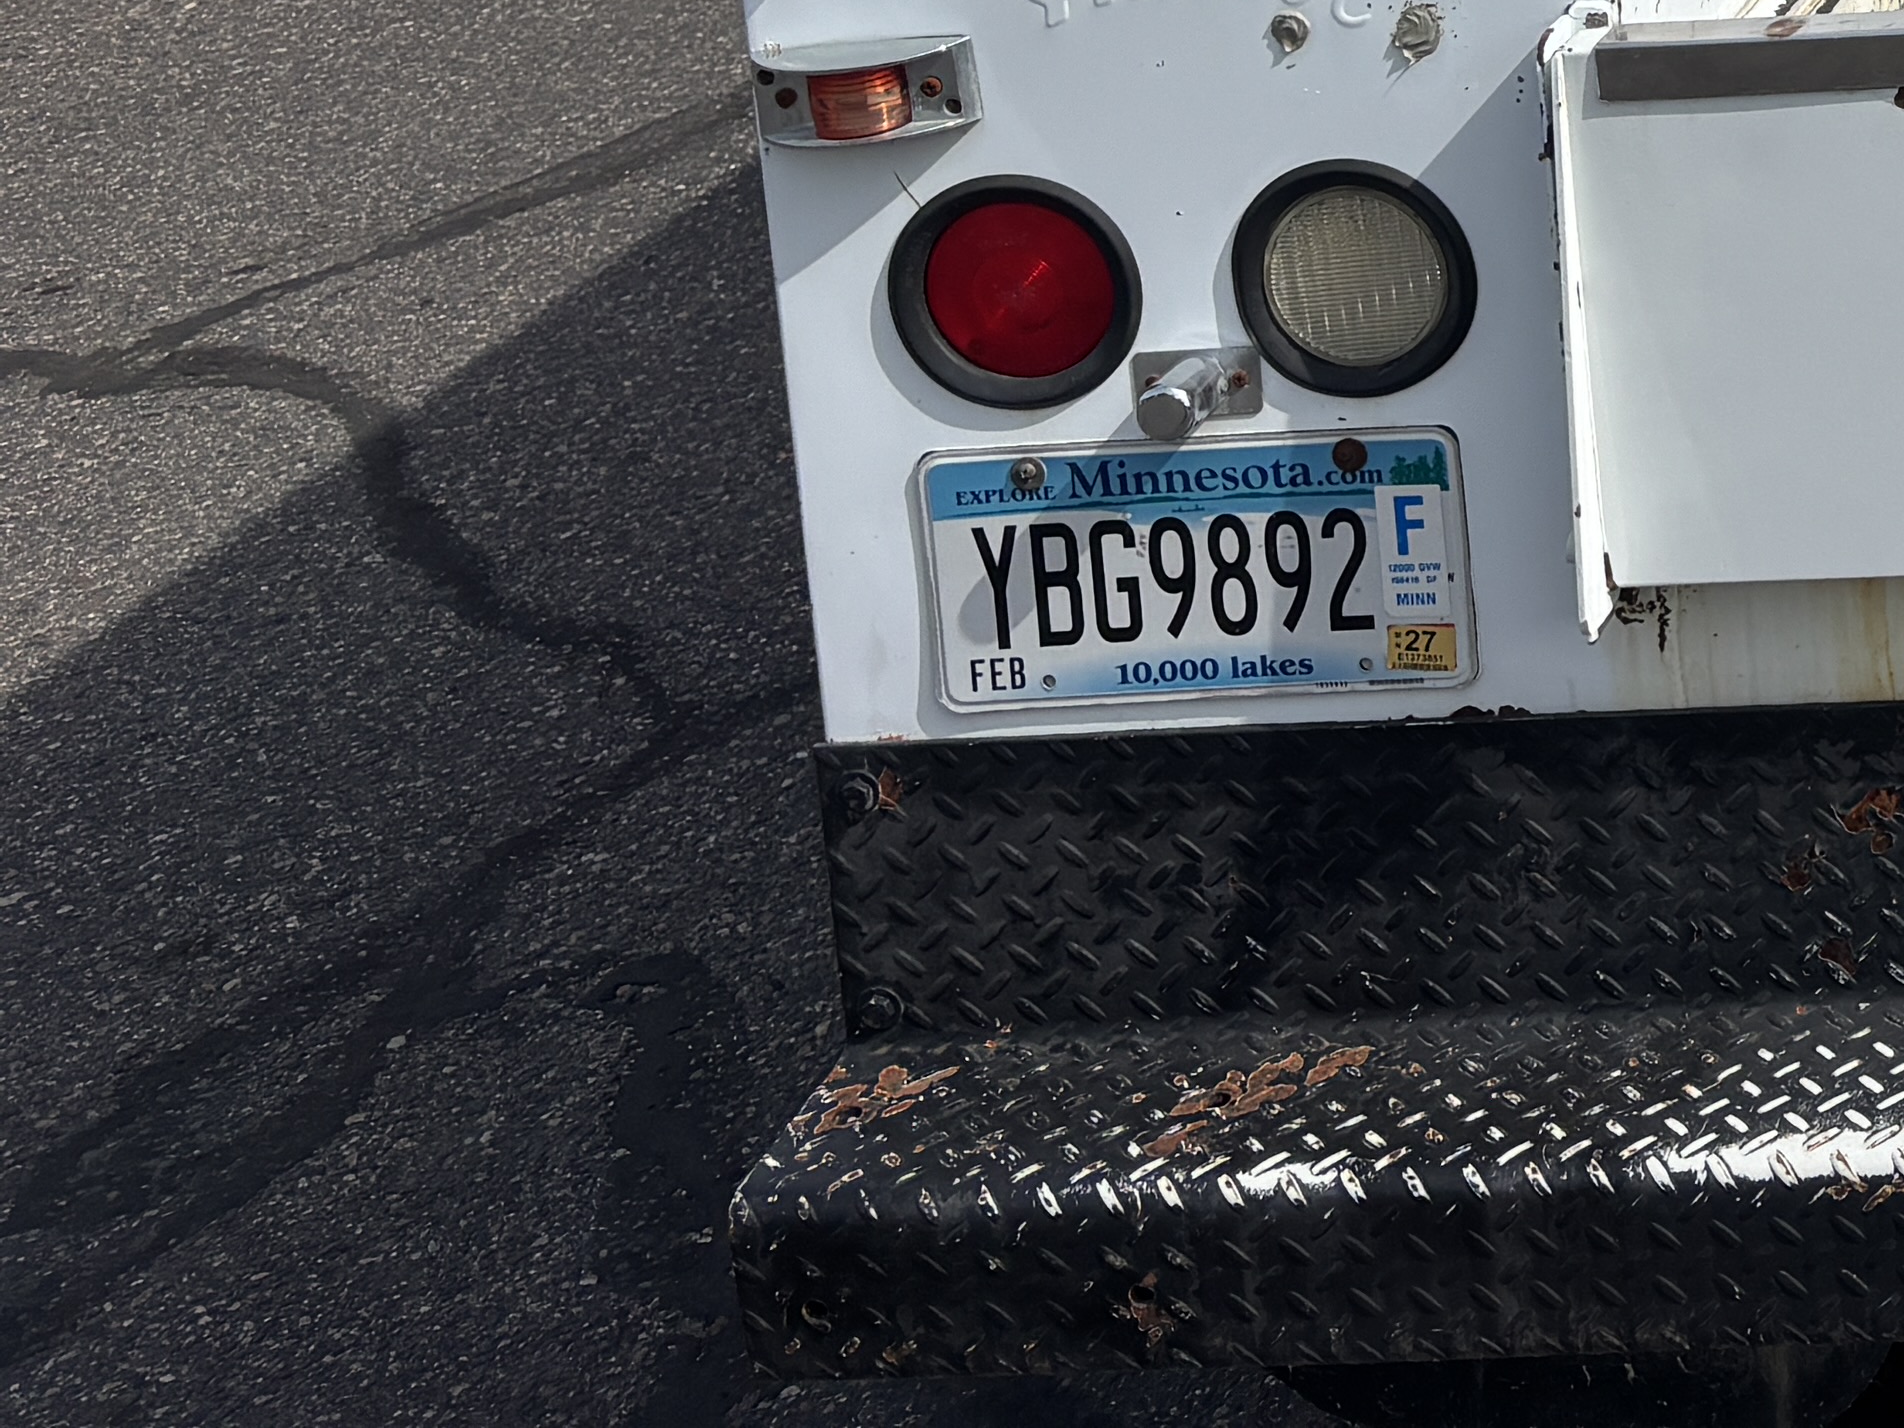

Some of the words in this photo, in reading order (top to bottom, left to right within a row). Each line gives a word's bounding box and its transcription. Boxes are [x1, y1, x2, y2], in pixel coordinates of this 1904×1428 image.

[955, 484, 1057, 506] EXPLORE
[1393, 495, 1425, 556] F
[970, 507, 1376, 651] YBG9892
[1396, 592, 1436, 606] MINN
[1404, 629, 1437, 652] 27
[969, 657, 1027, 693] FEB
[1114, 658, 1220, 688] 10,000
[1230, 654, 1315, 680] lakes
